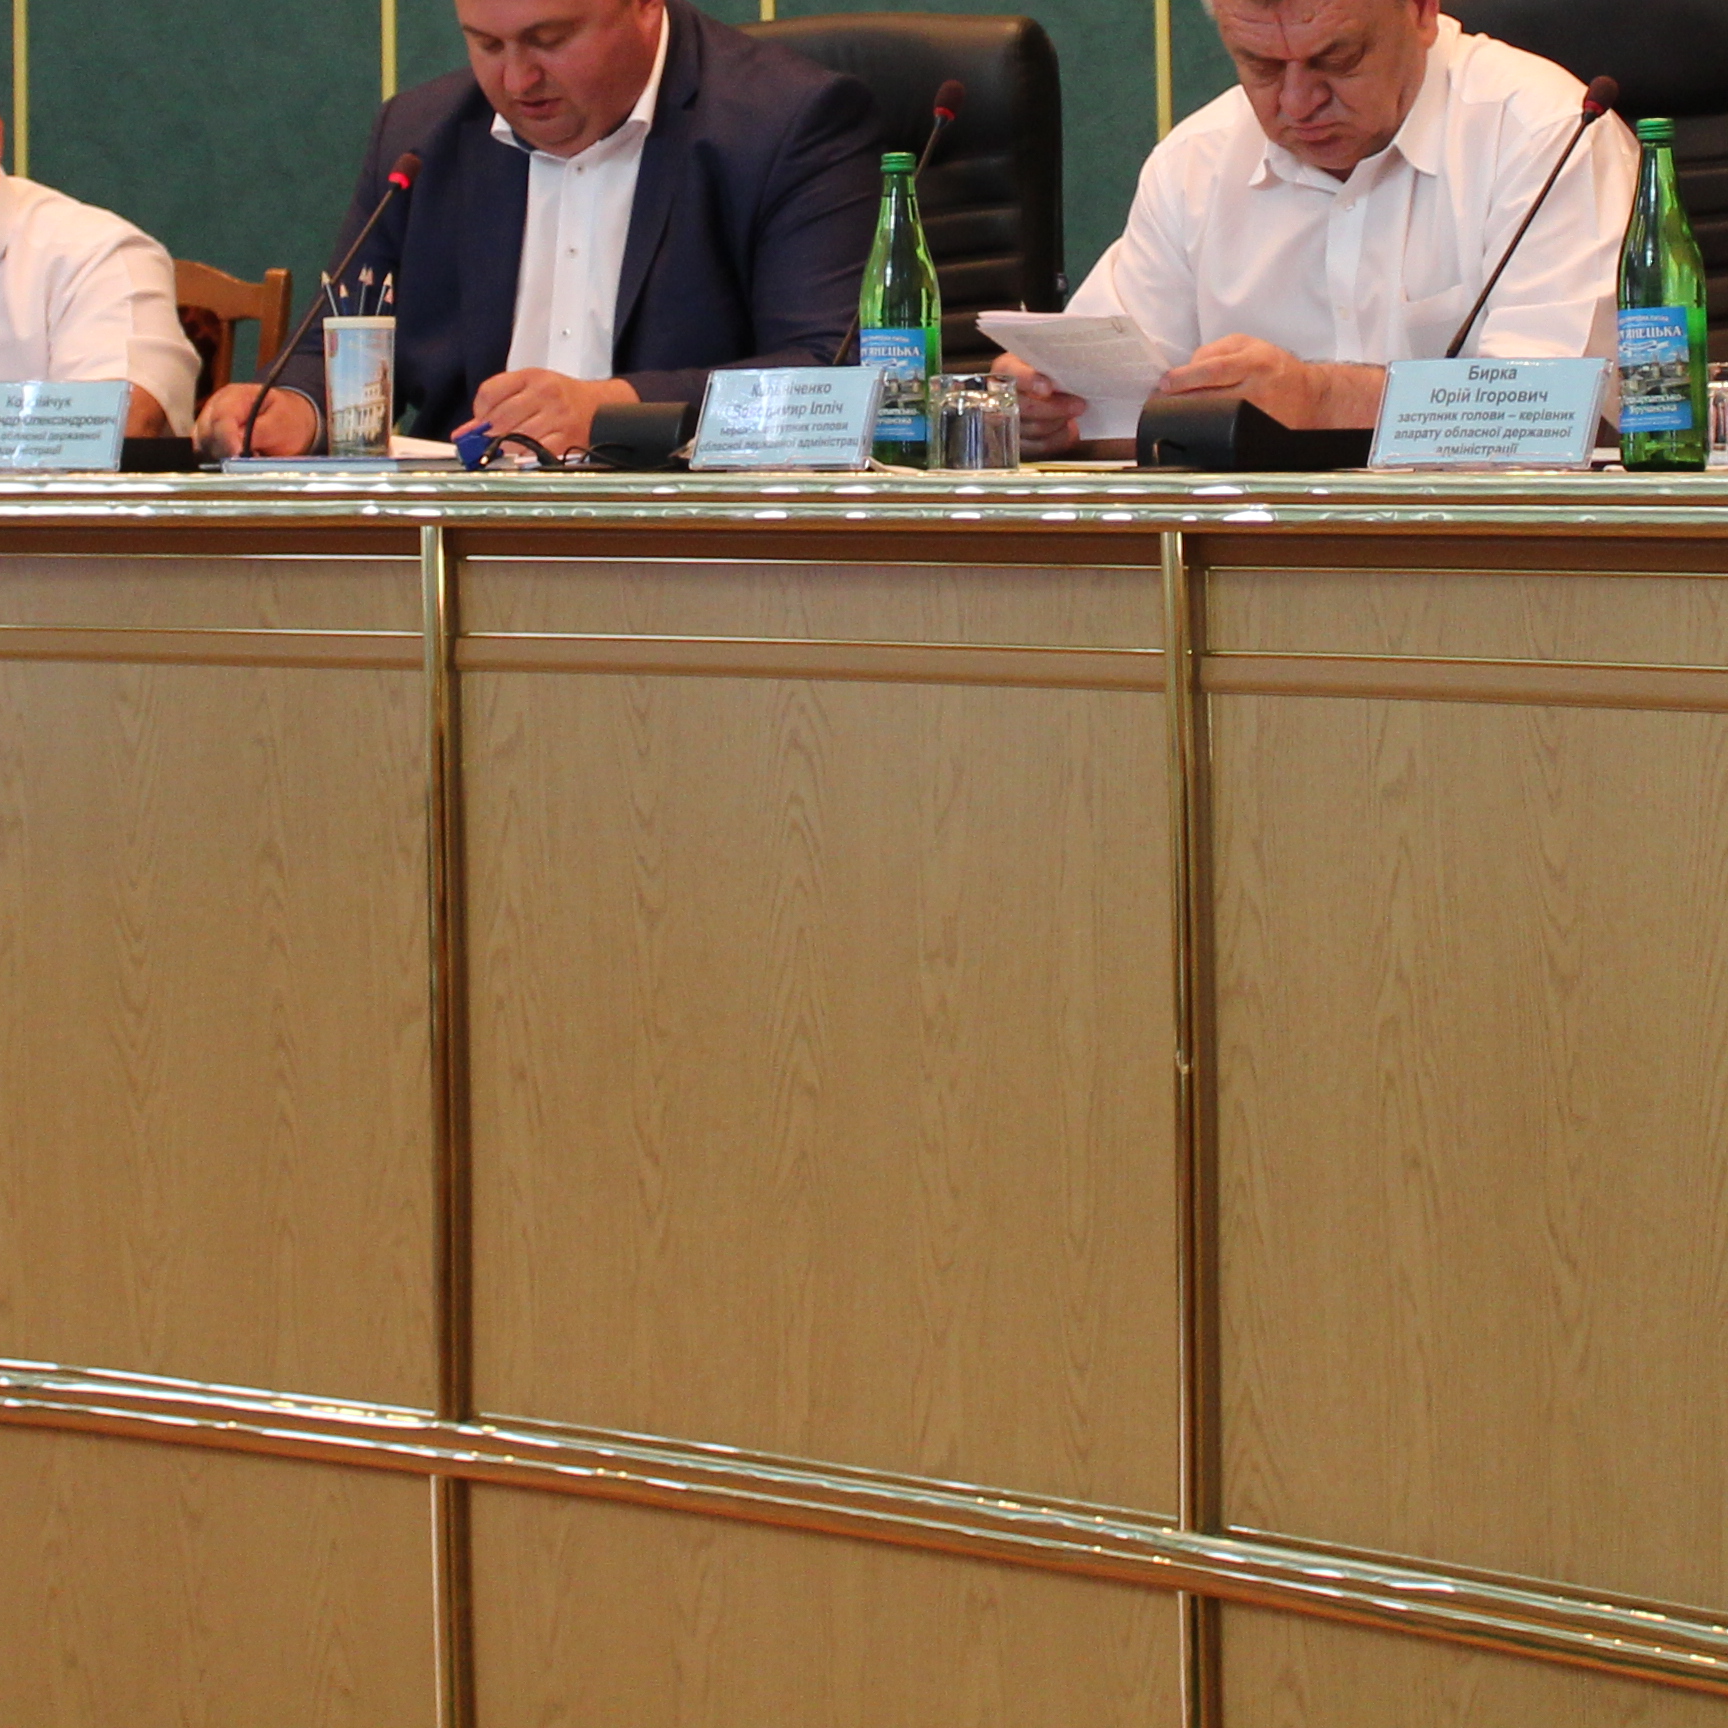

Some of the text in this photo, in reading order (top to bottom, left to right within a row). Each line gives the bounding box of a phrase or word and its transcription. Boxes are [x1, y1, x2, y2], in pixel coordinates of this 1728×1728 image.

[1468, 364, 1518, 383] Бирка
[1430, 387, 1548, 405] Юрій Ігорович
[810, 400, 844, 415] Ілліч
[1397, 412, 1458, 424] заступник
[1461, 411, 1505, 421] голови
[1519, 408, 1575, 423] керівник
[811, 421, 849, 432] голови
[1394, 426, 1572, 440] апарату обласної державної
[1436, 443, 1520, 456] адміністрації
